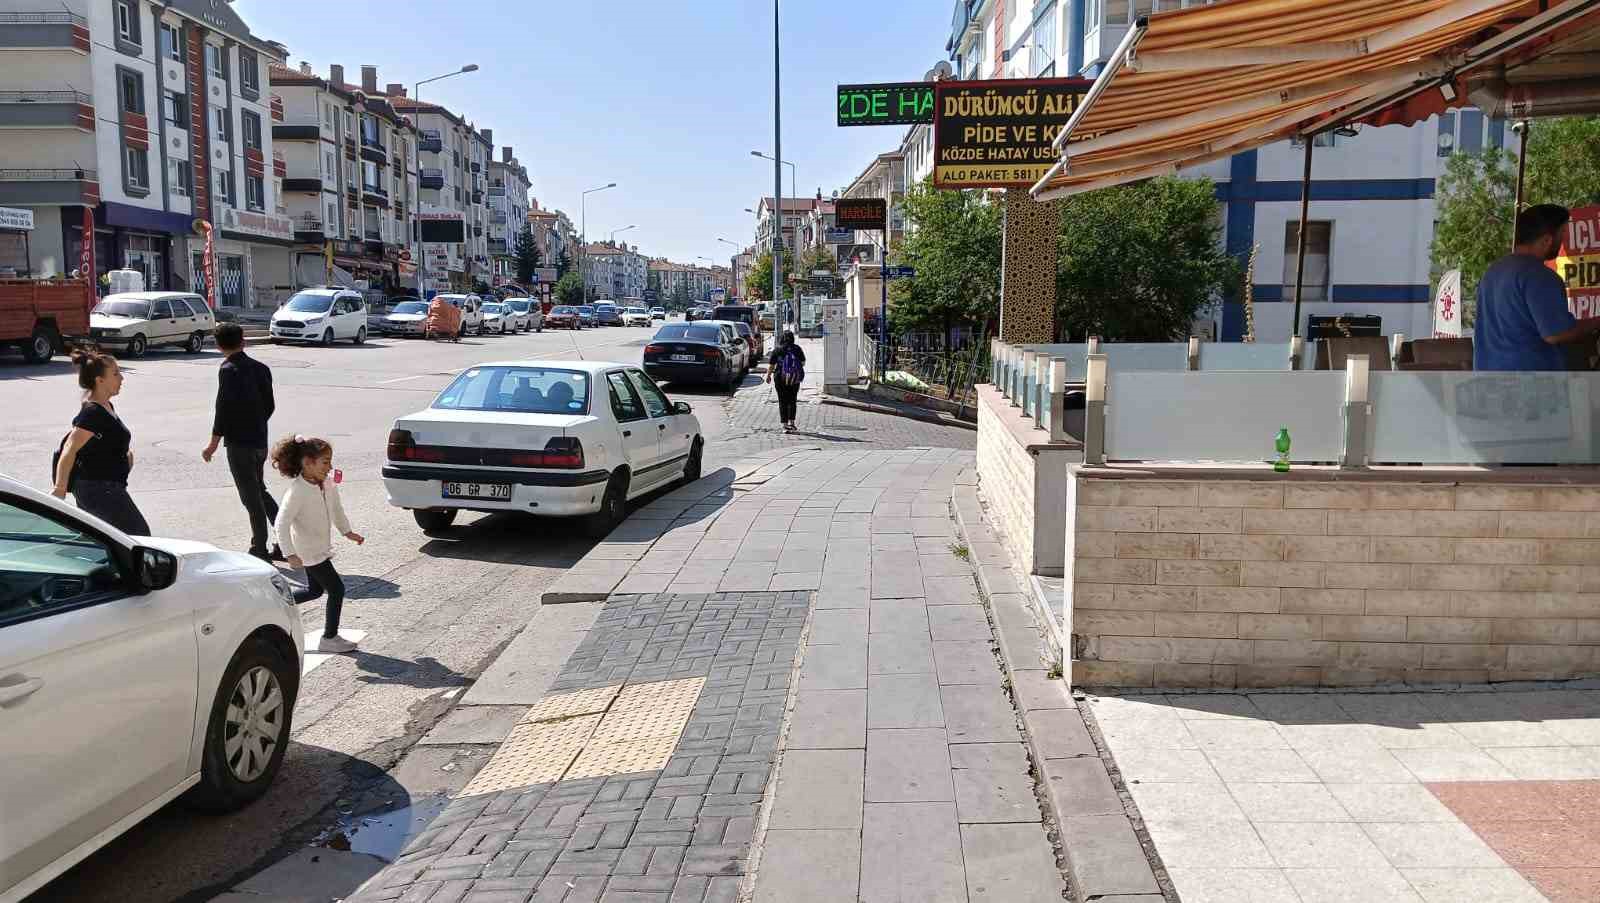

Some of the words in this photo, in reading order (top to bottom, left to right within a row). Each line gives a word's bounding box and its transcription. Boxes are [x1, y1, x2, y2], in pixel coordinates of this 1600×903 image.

[840, 93, 888, 118] ZDE
[944, 89, 1038, 117] DÜRÜMCÜ
[964, 123, 1008, 143] PİDE
[1012, 126, 1038, 142] VE
[942, 146, 985, 161] KÖZDE
[988, 147, 1032, 160] HATAY
[944, 170, 966, 181] ALO
[970, 169, 1010, 181] PAKET:
[449, 483, 461, 494] 06
[490, 485, 508, 497] 370
